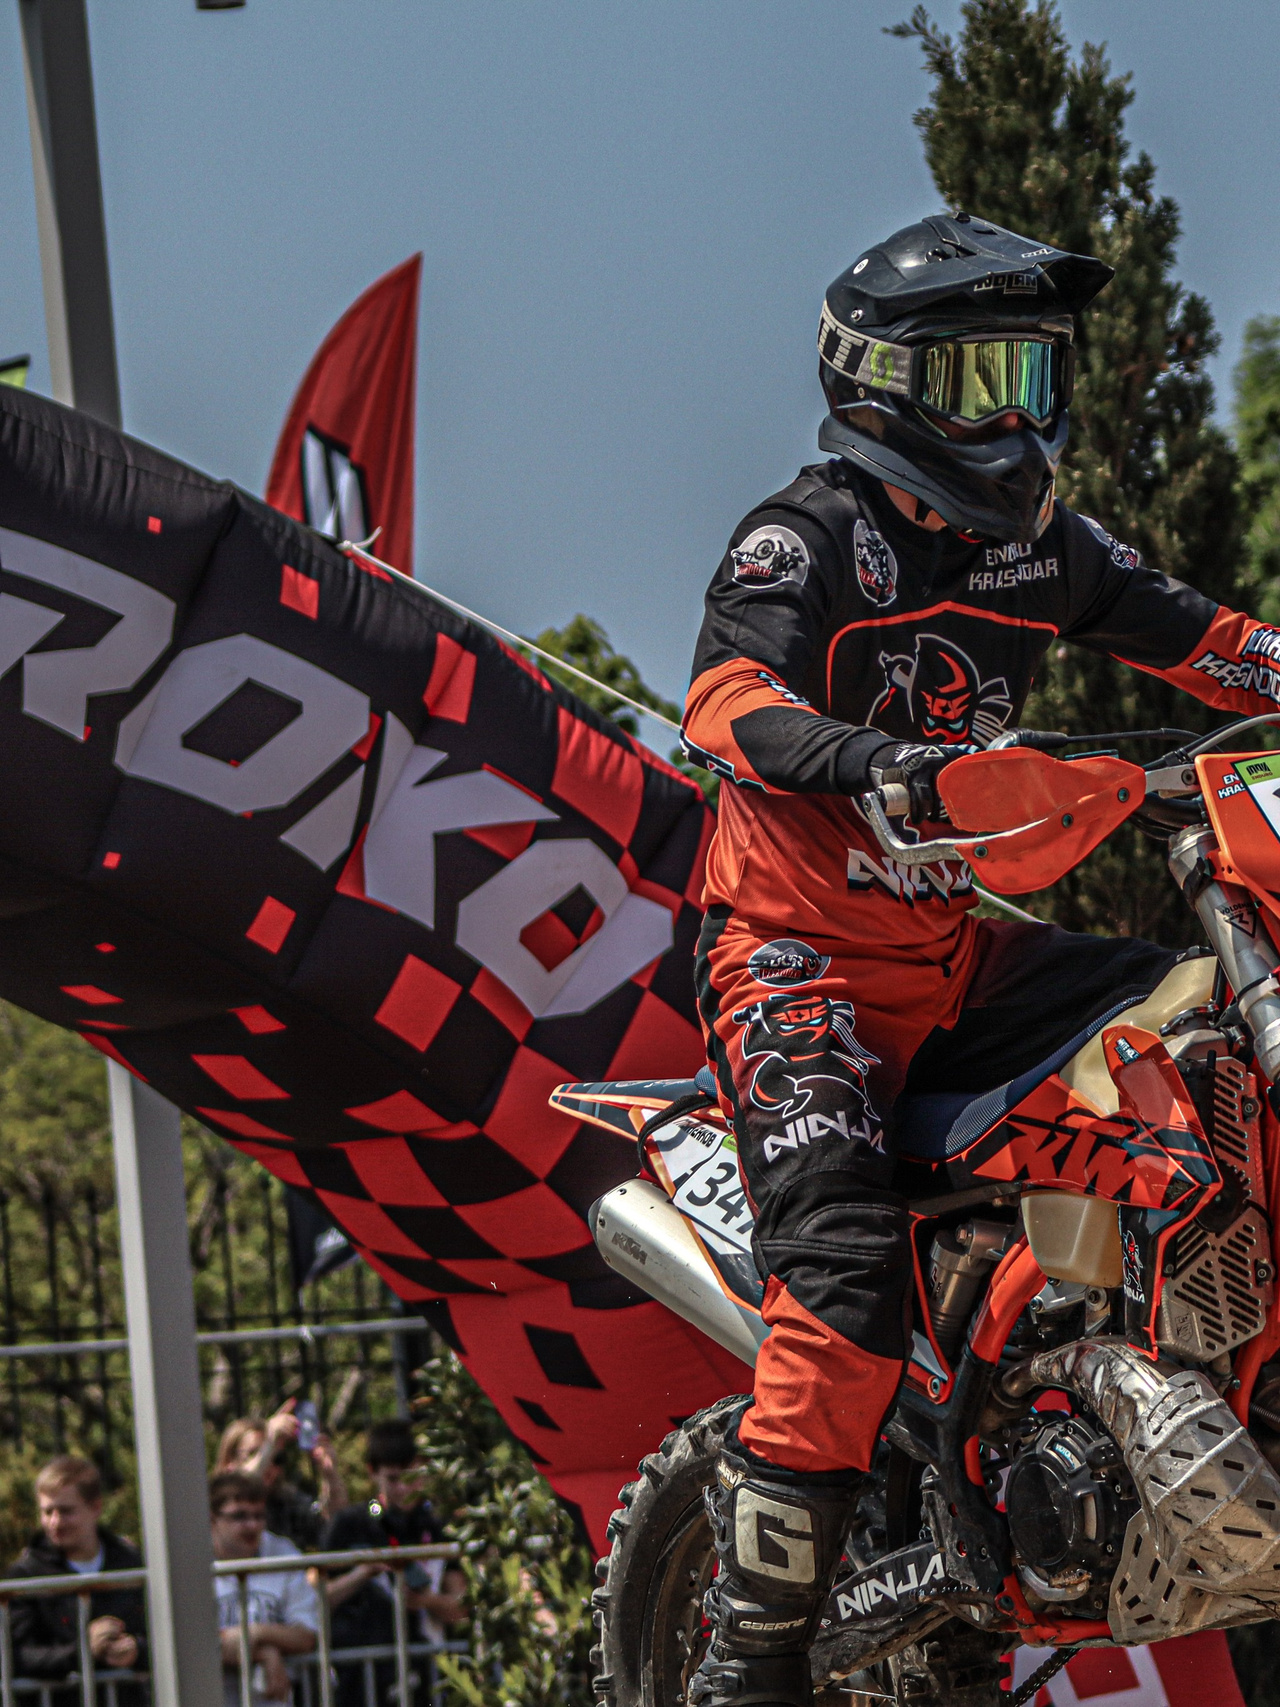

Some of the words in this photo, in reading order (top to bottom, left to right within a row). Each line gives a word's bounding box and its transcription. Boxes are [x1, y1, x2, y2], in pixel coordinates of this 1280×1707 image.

[0, 527, 674, 1019] ROKO
[847, 848, 973, 907] NINJ
[763, 1110, 887, 1163] NINJA
[972, 1113, 1184, 1209] KTM
[611, 1231, 649, 1265] KTM
[837, 1553, 945, 1620] NINJA
